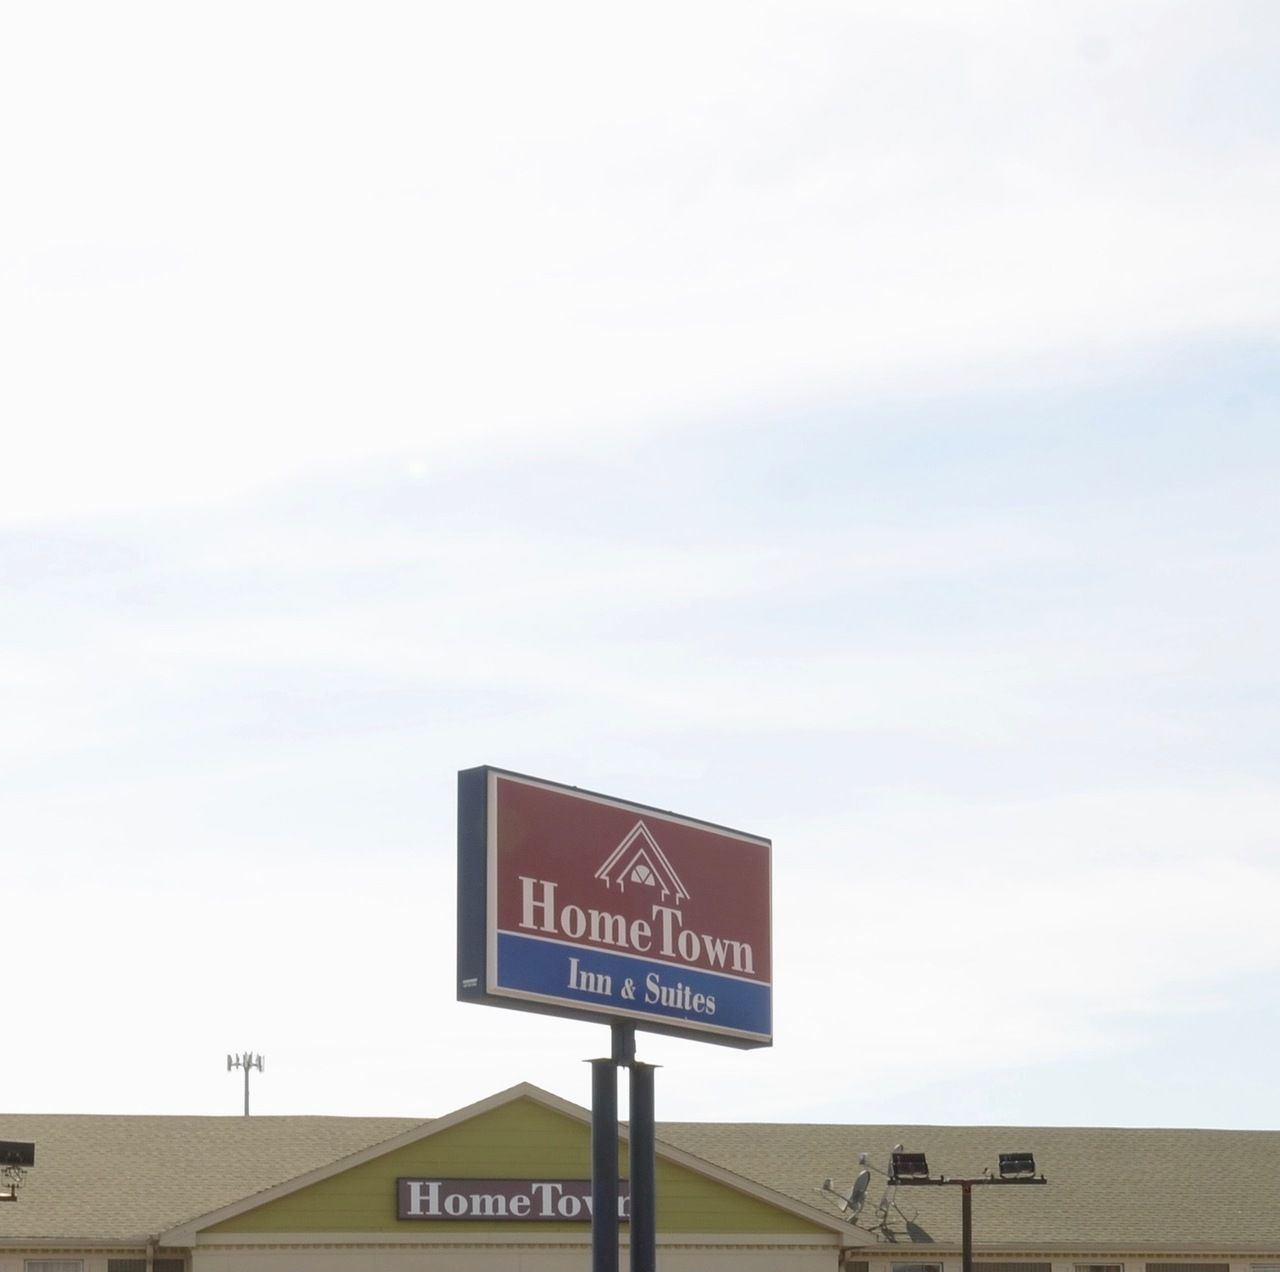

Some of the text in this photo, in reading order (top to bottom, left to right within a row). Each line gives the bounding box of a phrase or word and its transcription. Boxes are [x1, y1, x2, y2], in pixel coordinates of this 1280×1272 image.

[518, 875, 756, 976] HomeTown
[567, 956, 716, 1016] Inn & Suites
